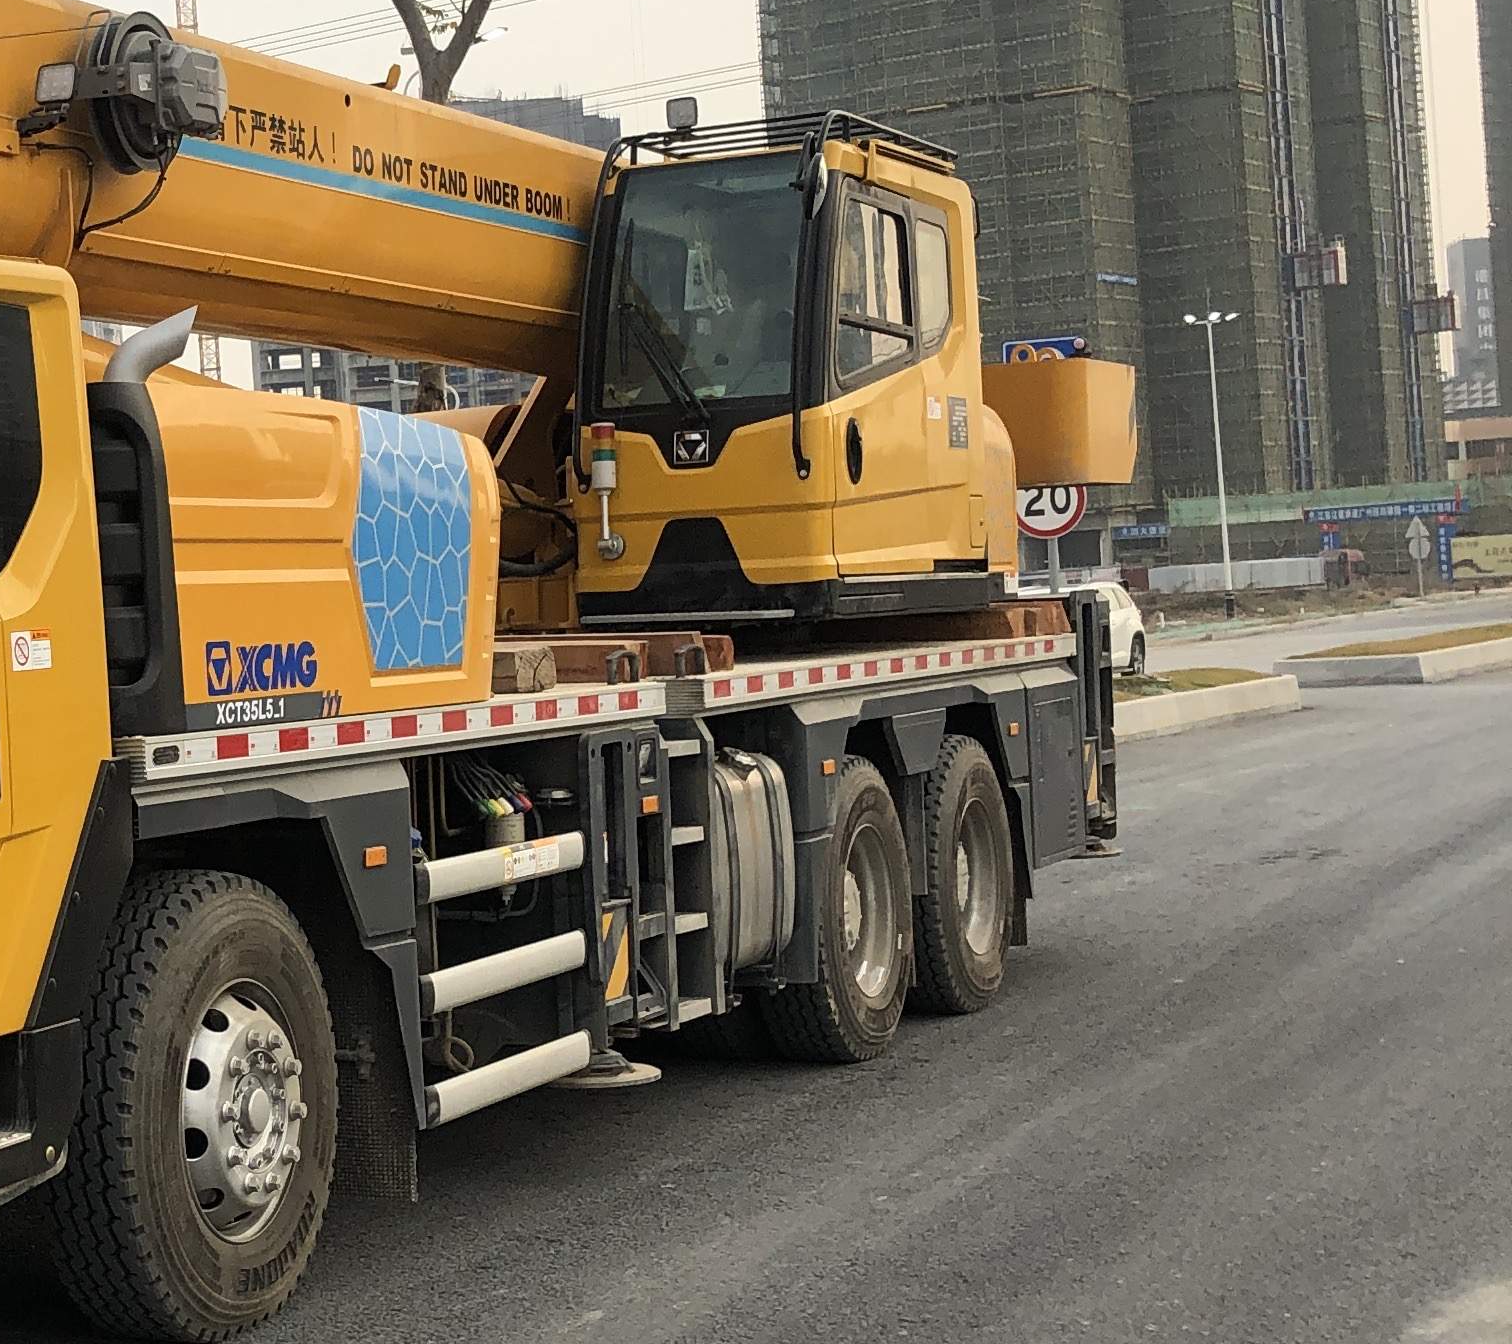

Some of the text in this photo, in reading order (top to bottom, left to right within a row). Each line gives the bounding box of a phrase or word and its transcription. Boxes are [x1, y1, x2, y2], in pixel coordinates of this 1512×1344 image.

[352, 145, 374, 176] DO
[382, 152, 413, 184] NOT
[420, 162, 467, 197] STAND
[474, 177, 519, 210] UNDER
[1024, 487, 1072, 517] 20
[234, 641, 317, 693] XCMG
[216, 698, 285, 725] XCT35L5_1
